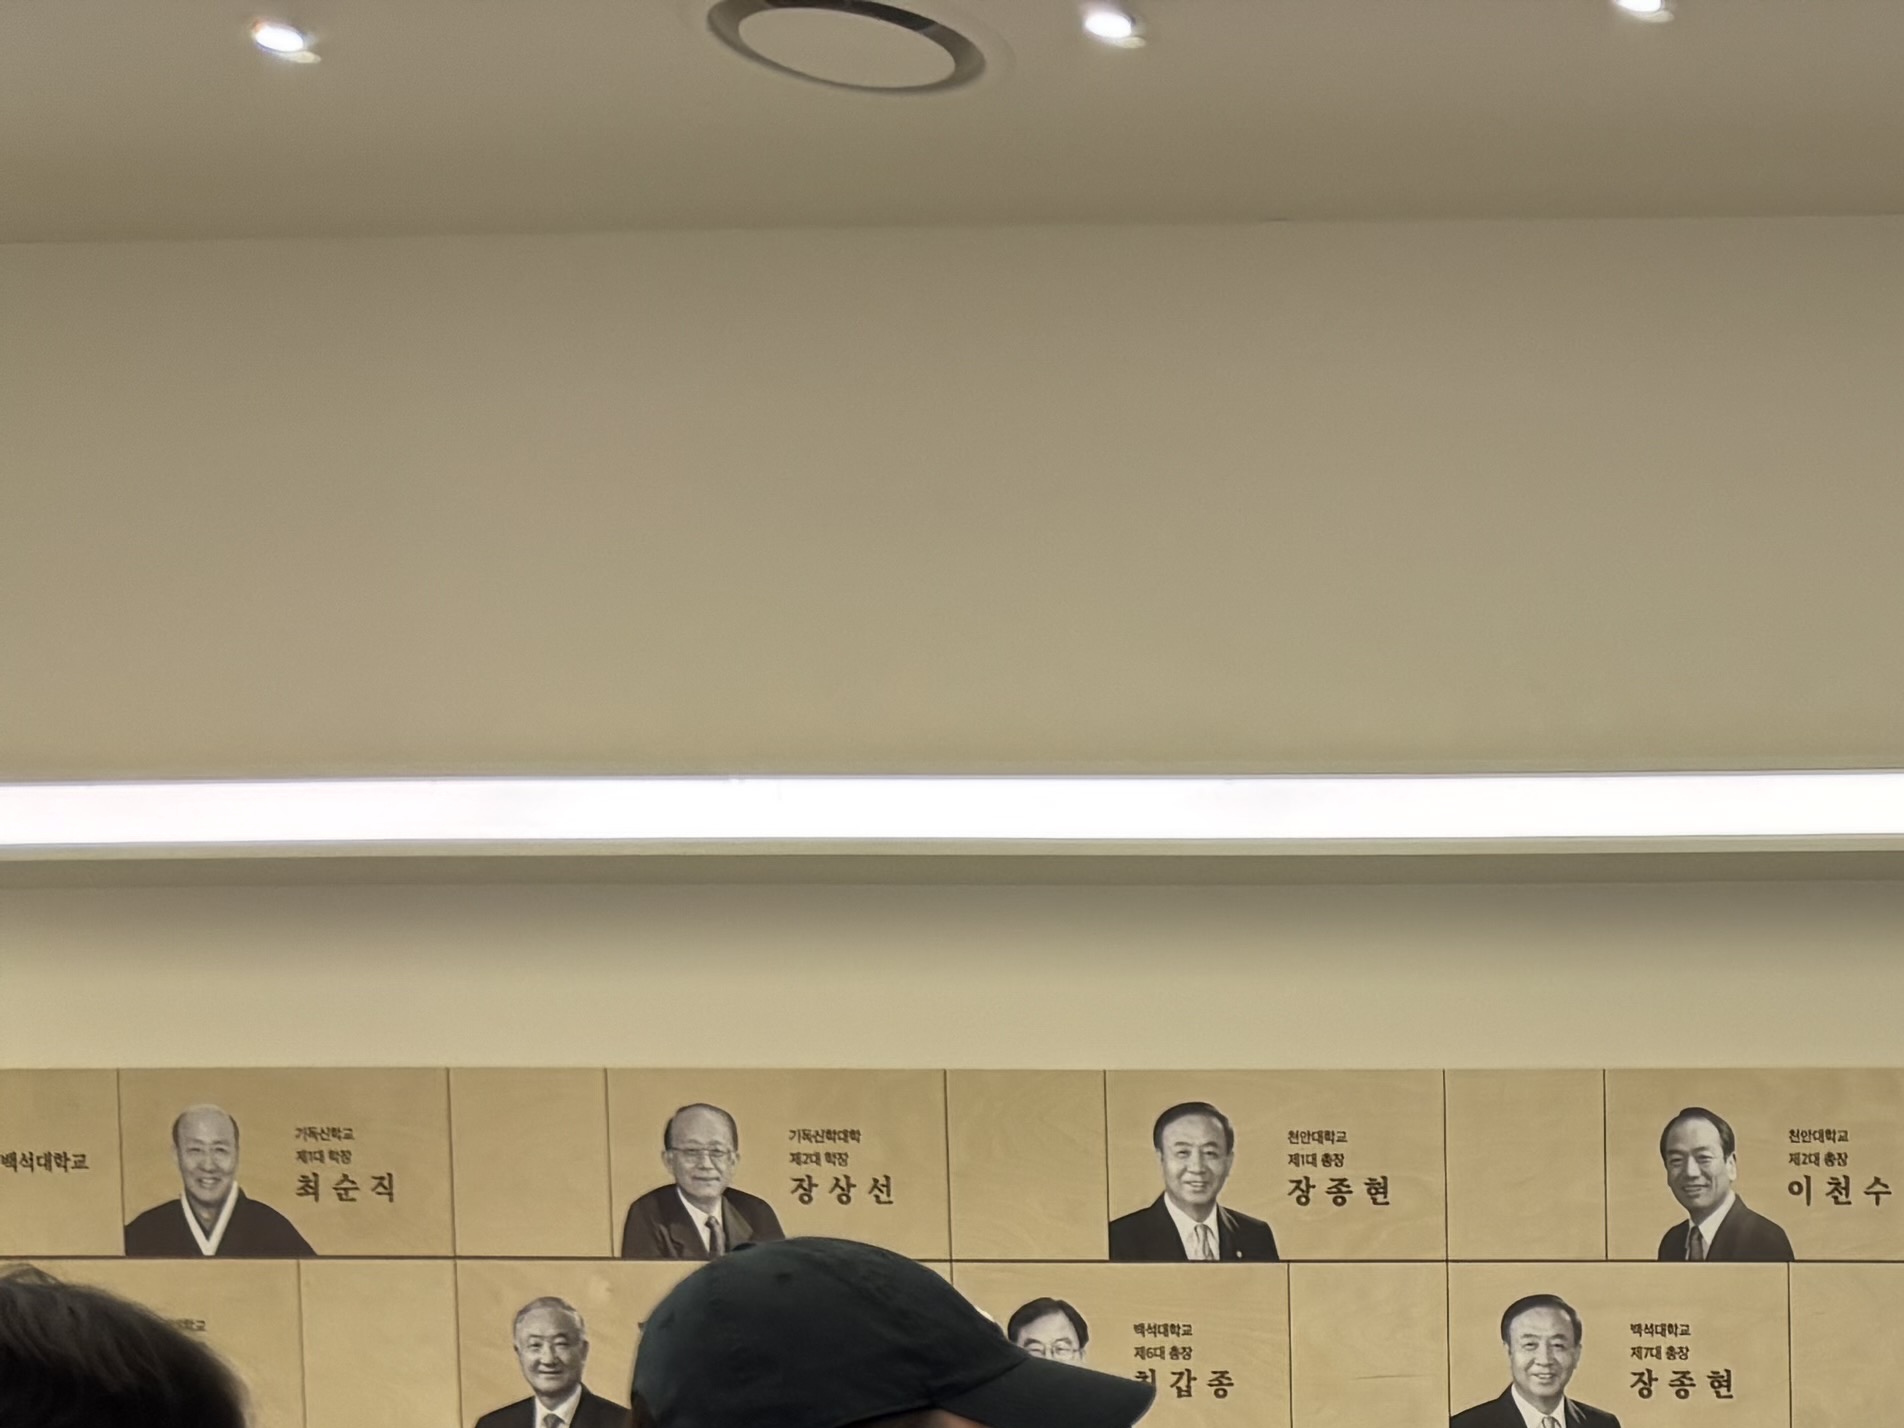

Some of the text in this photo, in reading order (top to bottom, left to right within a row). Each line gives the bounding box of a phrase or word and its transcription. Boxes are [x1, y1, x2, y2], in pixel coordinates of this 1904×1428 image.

[788, 1128, 862, 1144] 기독신학대학
[1287, 1129, 1348, 1145] 천안대학교
[1788, 1128, 1849, 1144] 천안대학교
[0, 1151, 90, 1173] 백석대학교
[295, 1149, 353, 1165] 제1대 학장
[789, 1151, 849, 1167] 제2대 학장
[1287, 1152, 1345, 1168] 제1대 총장
[1788, 1151, 1849, 1168] 제2대 총장
[295, 1171, 394, 1204] 최순직
[790, 1173, 894, 1206] 장상선
[1287, 1175, 1391, 1208] 장종현
[1787, 1174, 1893, 1207] 이천수
[1133, 1322, 1193, 1338] 백석대학교
[1629, 1322, 1692, 1338] 백석대학교
[1133, 1345, 1193, 1361] 제6대 총장
[1630, 1345, 1690, 1361] 제7대 총장
[1629, 1367, 1734, 1400] 장종현
